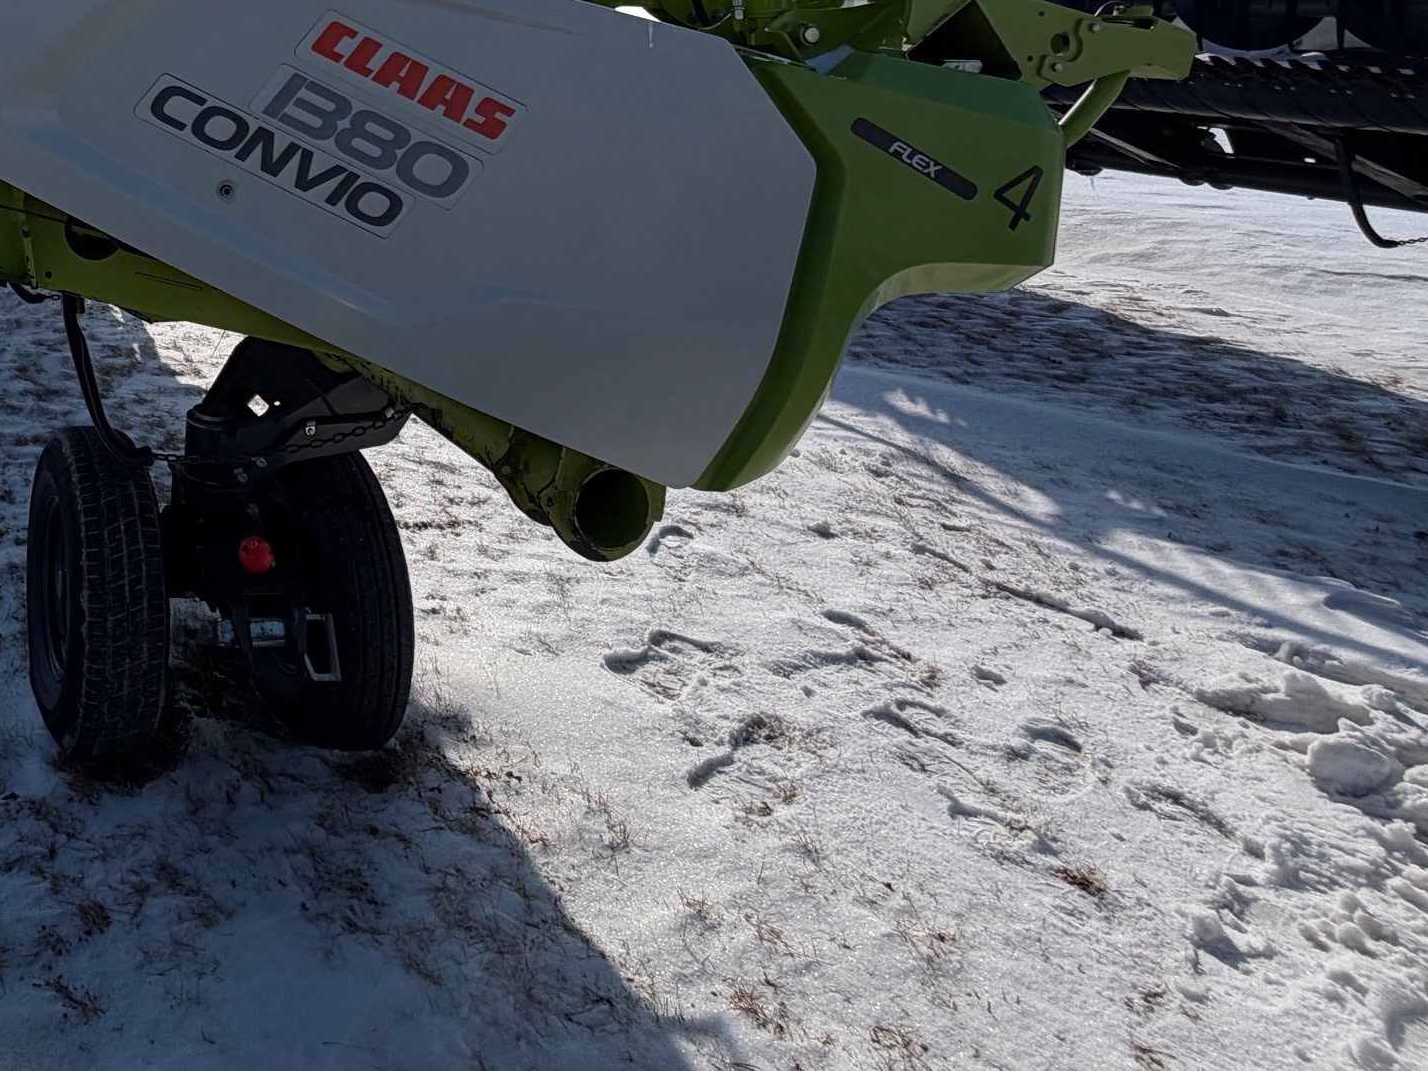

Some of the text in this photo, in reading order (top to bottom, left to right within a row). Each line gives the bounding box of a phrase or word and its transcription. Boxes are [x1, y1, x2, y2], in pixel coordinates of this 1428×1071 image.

[311, 21, 516, 140] CLAAS
[150, 85, 403, 226] CONVIO
[889, 141, 943, 178] FLEX
[993, 165, 1043, 230] 4
